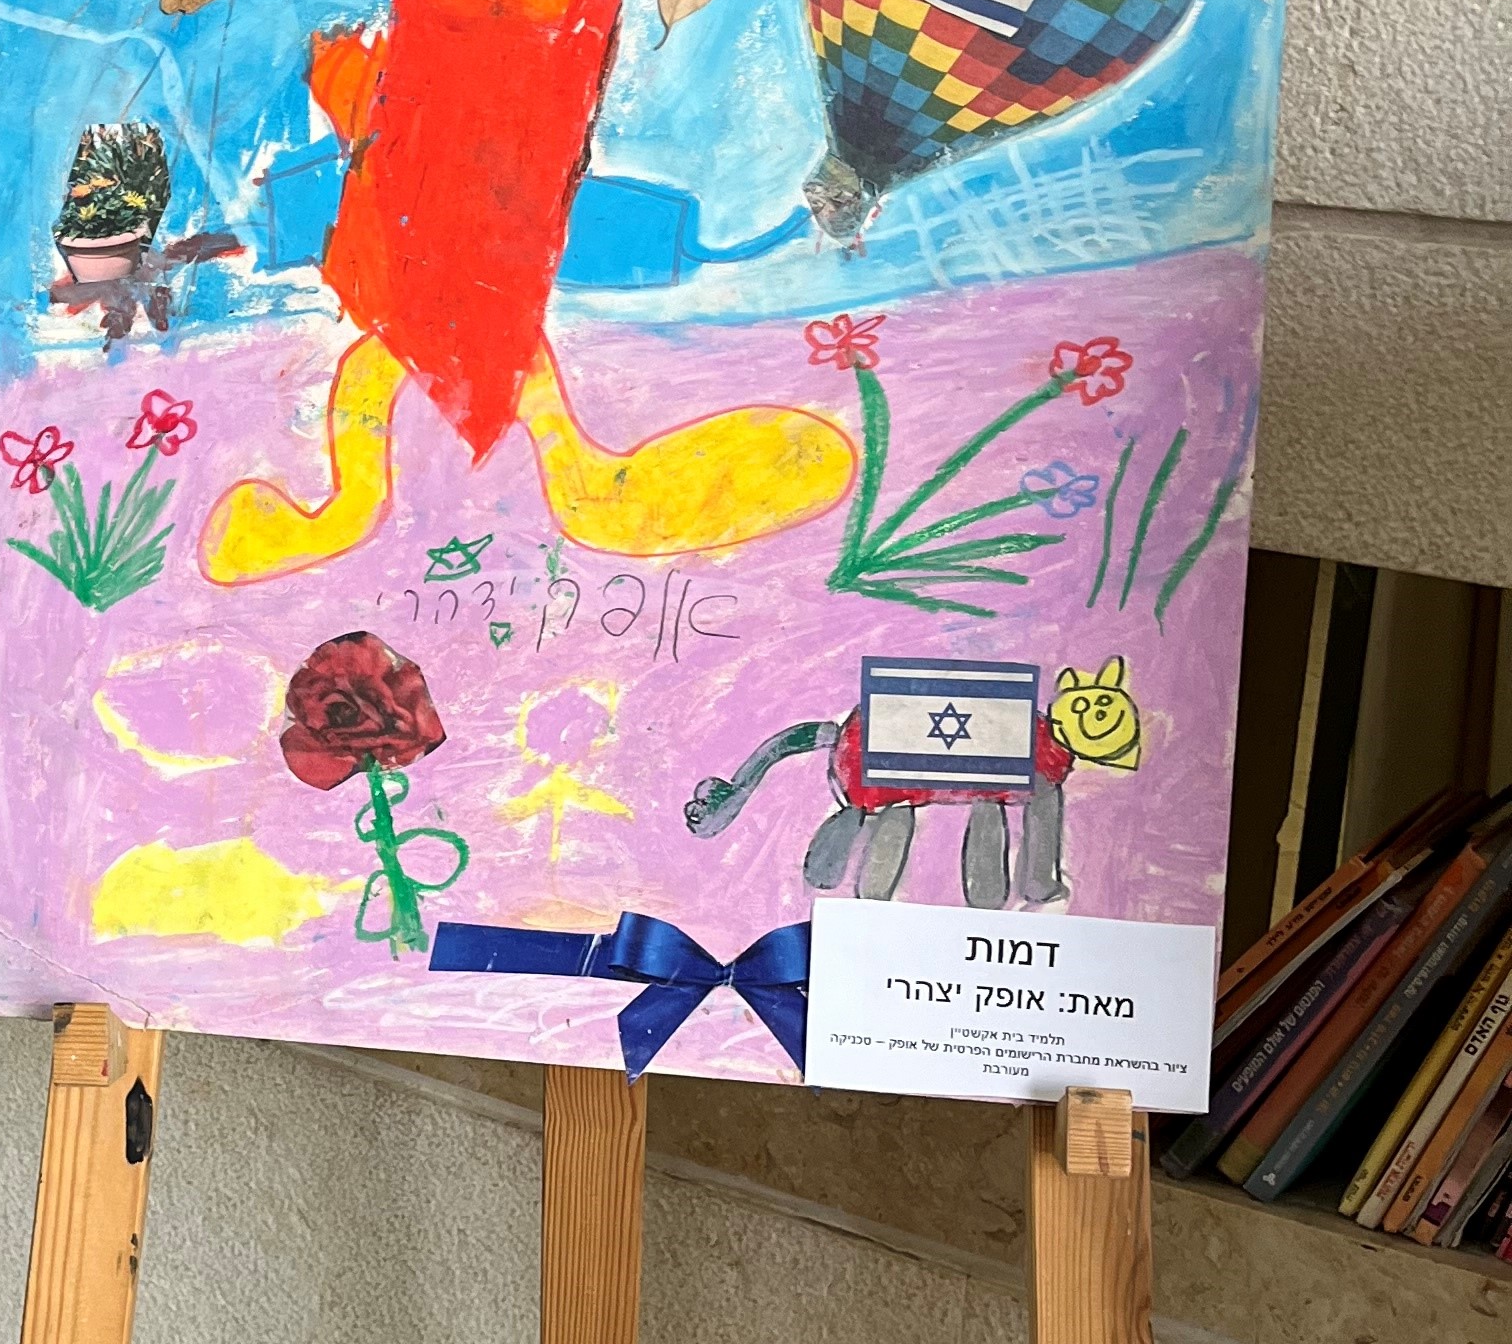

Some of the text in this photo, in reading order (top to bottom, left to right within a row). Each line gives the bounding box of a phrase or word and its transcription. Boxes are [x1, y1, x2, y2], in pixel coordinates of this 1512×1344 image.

[965, 936, 1060, 967] דמות
[886, 978, 1135, 1018] מאת: אופק יצהרי
[1490, 993, 1511, 1017] גוף
[1002, 1031, 1024, 1042] בית
[1029, 1033, 1065, 1045] תלמיד
[1230, 978, 1326, 1093] הפנטום של אולם המופעים
[1463, 1015, 1497, 1057] האדם
[888, 1038, 918, 1050] אופק
[922, 1039, 939, 1052] של
[995, 1048, 1051, 1062] הרישומים
[1056, 1053, 1100, 1066] מחברת
[982, 1063, 1029, 1076] מעורבת
[1104, 1057, 1159, 1071] בהשראת
[1164, 1062, 1188, 1073] ציור
